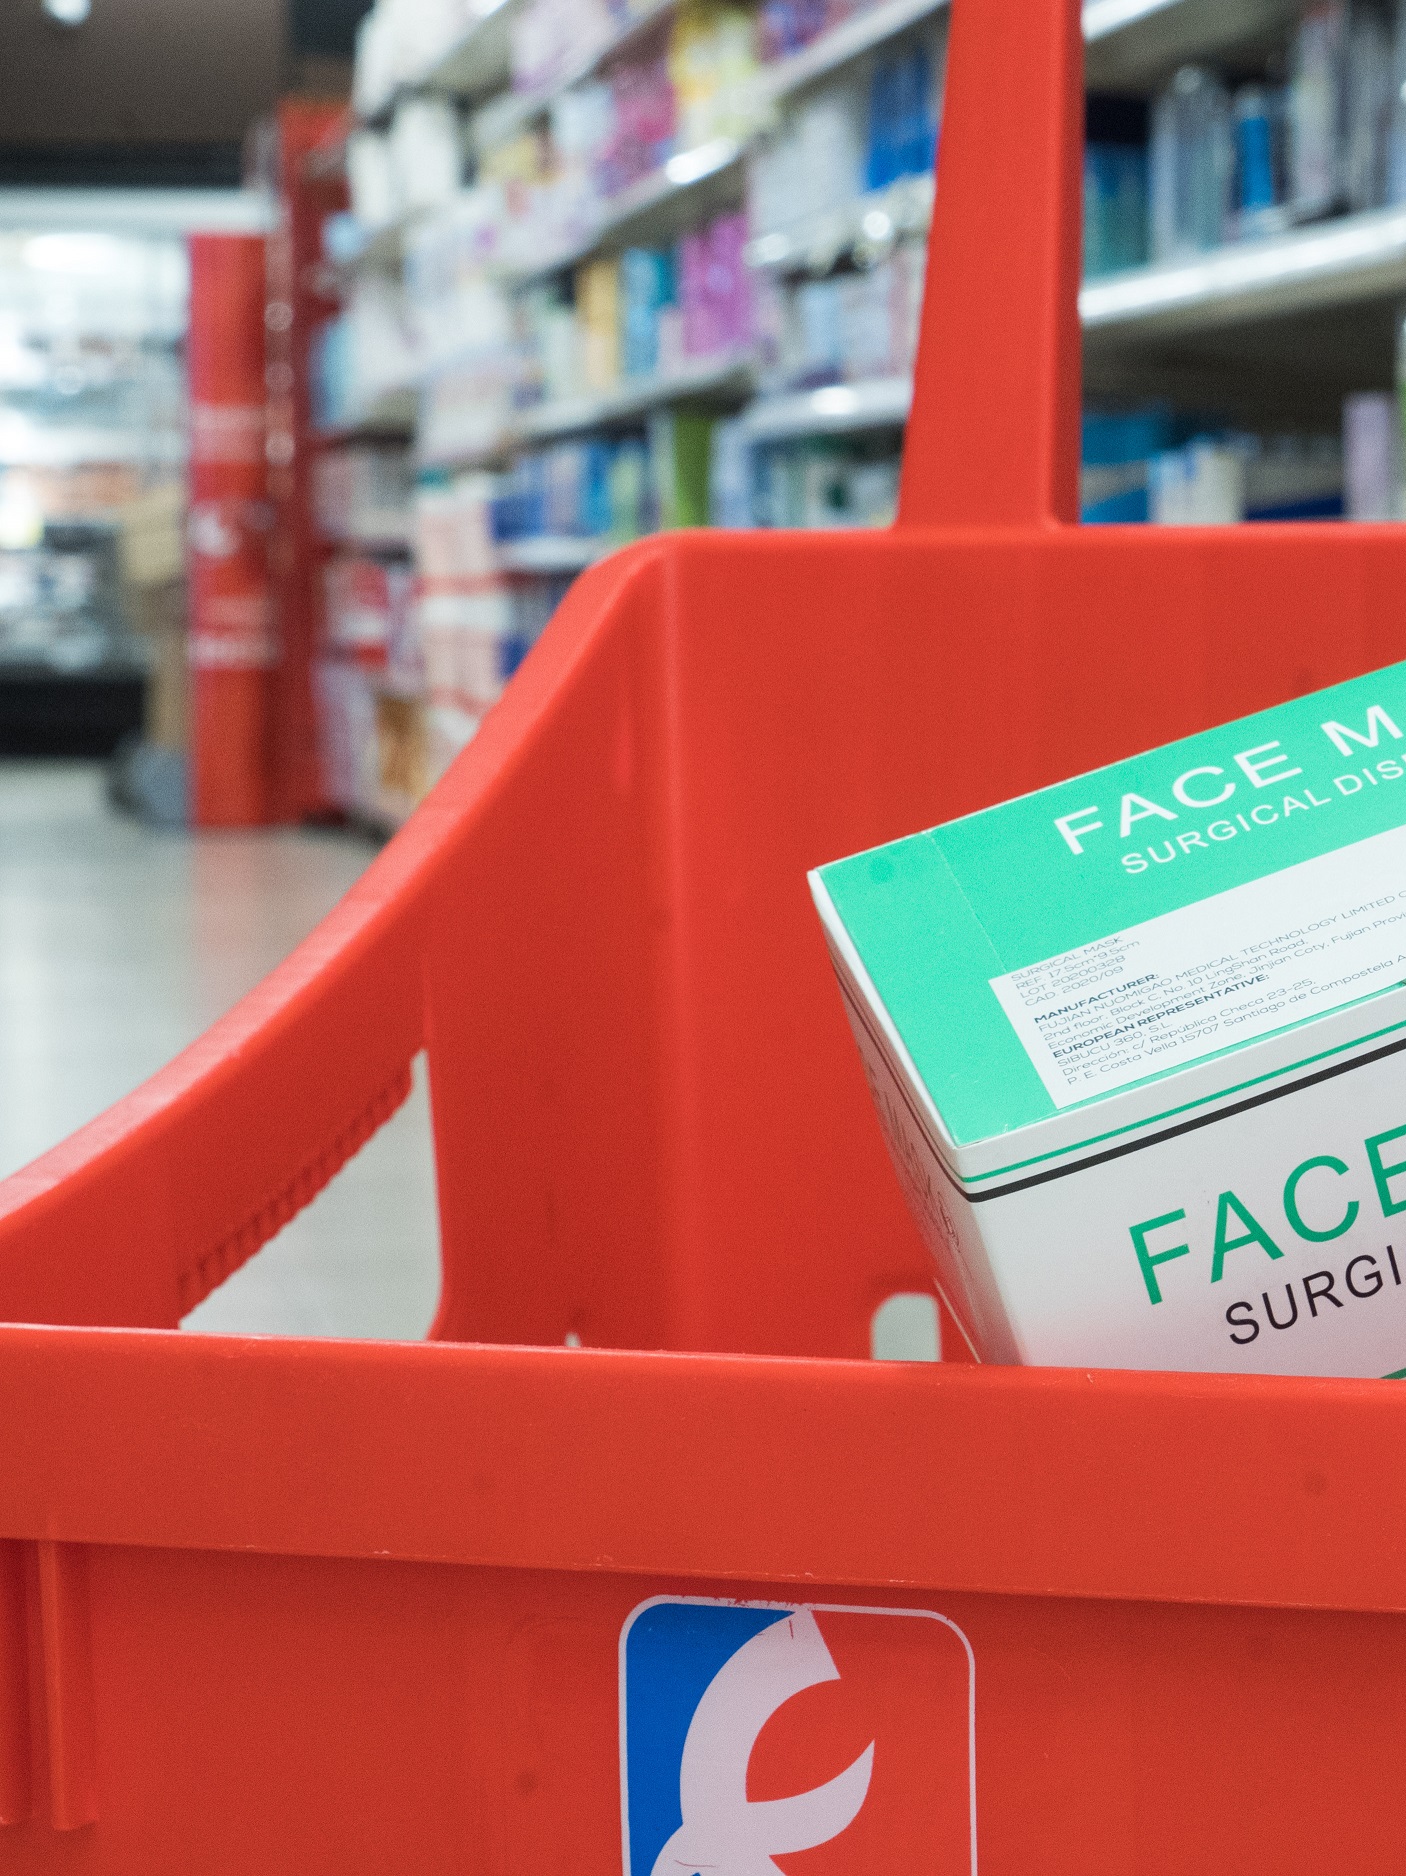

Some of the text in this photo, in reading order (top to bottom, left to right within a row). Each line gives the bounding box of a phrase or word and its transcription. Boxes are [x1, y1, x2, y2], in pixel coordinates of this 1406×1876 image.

[1053, 740, 1302, 856] FACE
[1121, 791, 1331, 874] SURGICAL
[1011, 936, 1122, 981] SURGICAL MASK
[1019, 954, 1125, 998] LOT 20200328
[1033, 973, 1159, 1023] MANUFACTURER:
[1038, 1008, 1091, 1032] FUJIAN
[1093, 977, 1172, 1011] NUOMIGAO
[1174, 954, 1238, 980] MEDICAL
[1239, 915, 1336, 955] TECHNOLOGY
[1340, 895, 1395, 919] LIMITED
[1042, 1025, 1071, 1040] 2nd
[1109, 999, 1145, 1016] Block
[1186, 976, 1203, 986] 10
[1204, 954, 1267, 980] LingShan
[1047, 1021, 1113, 1049] Economic
[1115, 986, 1205, 1024] Development
[1248, 955, 1291, 974] Jinjian
[1330, 926, 1371, 943] Fujian
[1061, 965, 1123, 993] 2020/09
[1052, 973, 1269, 1058] EUROPEAN REPRESENTATIVE:
[1057, 1042, 1110, 1067] SIBUCU
[1061, 1048, 1129, 1076] Dirección:
[1131, 1039, 1144, 1050] c/
[1148, 1015, 1217, 1043] República
[1219, 997, 1264, 1016] Checa
[1099, 1053, 1142, 1072] Costa
[1143, 1040, 1177, 1055] Vella
[1179, 1022, 1218, 1043] 15707
[1222, 1001, 1285, 1026] Santiago
[1288, 993, 1306, 1003] de
[1309, 960, 1393, 994] Compostela
[1397, 954, 1406, 962] A
